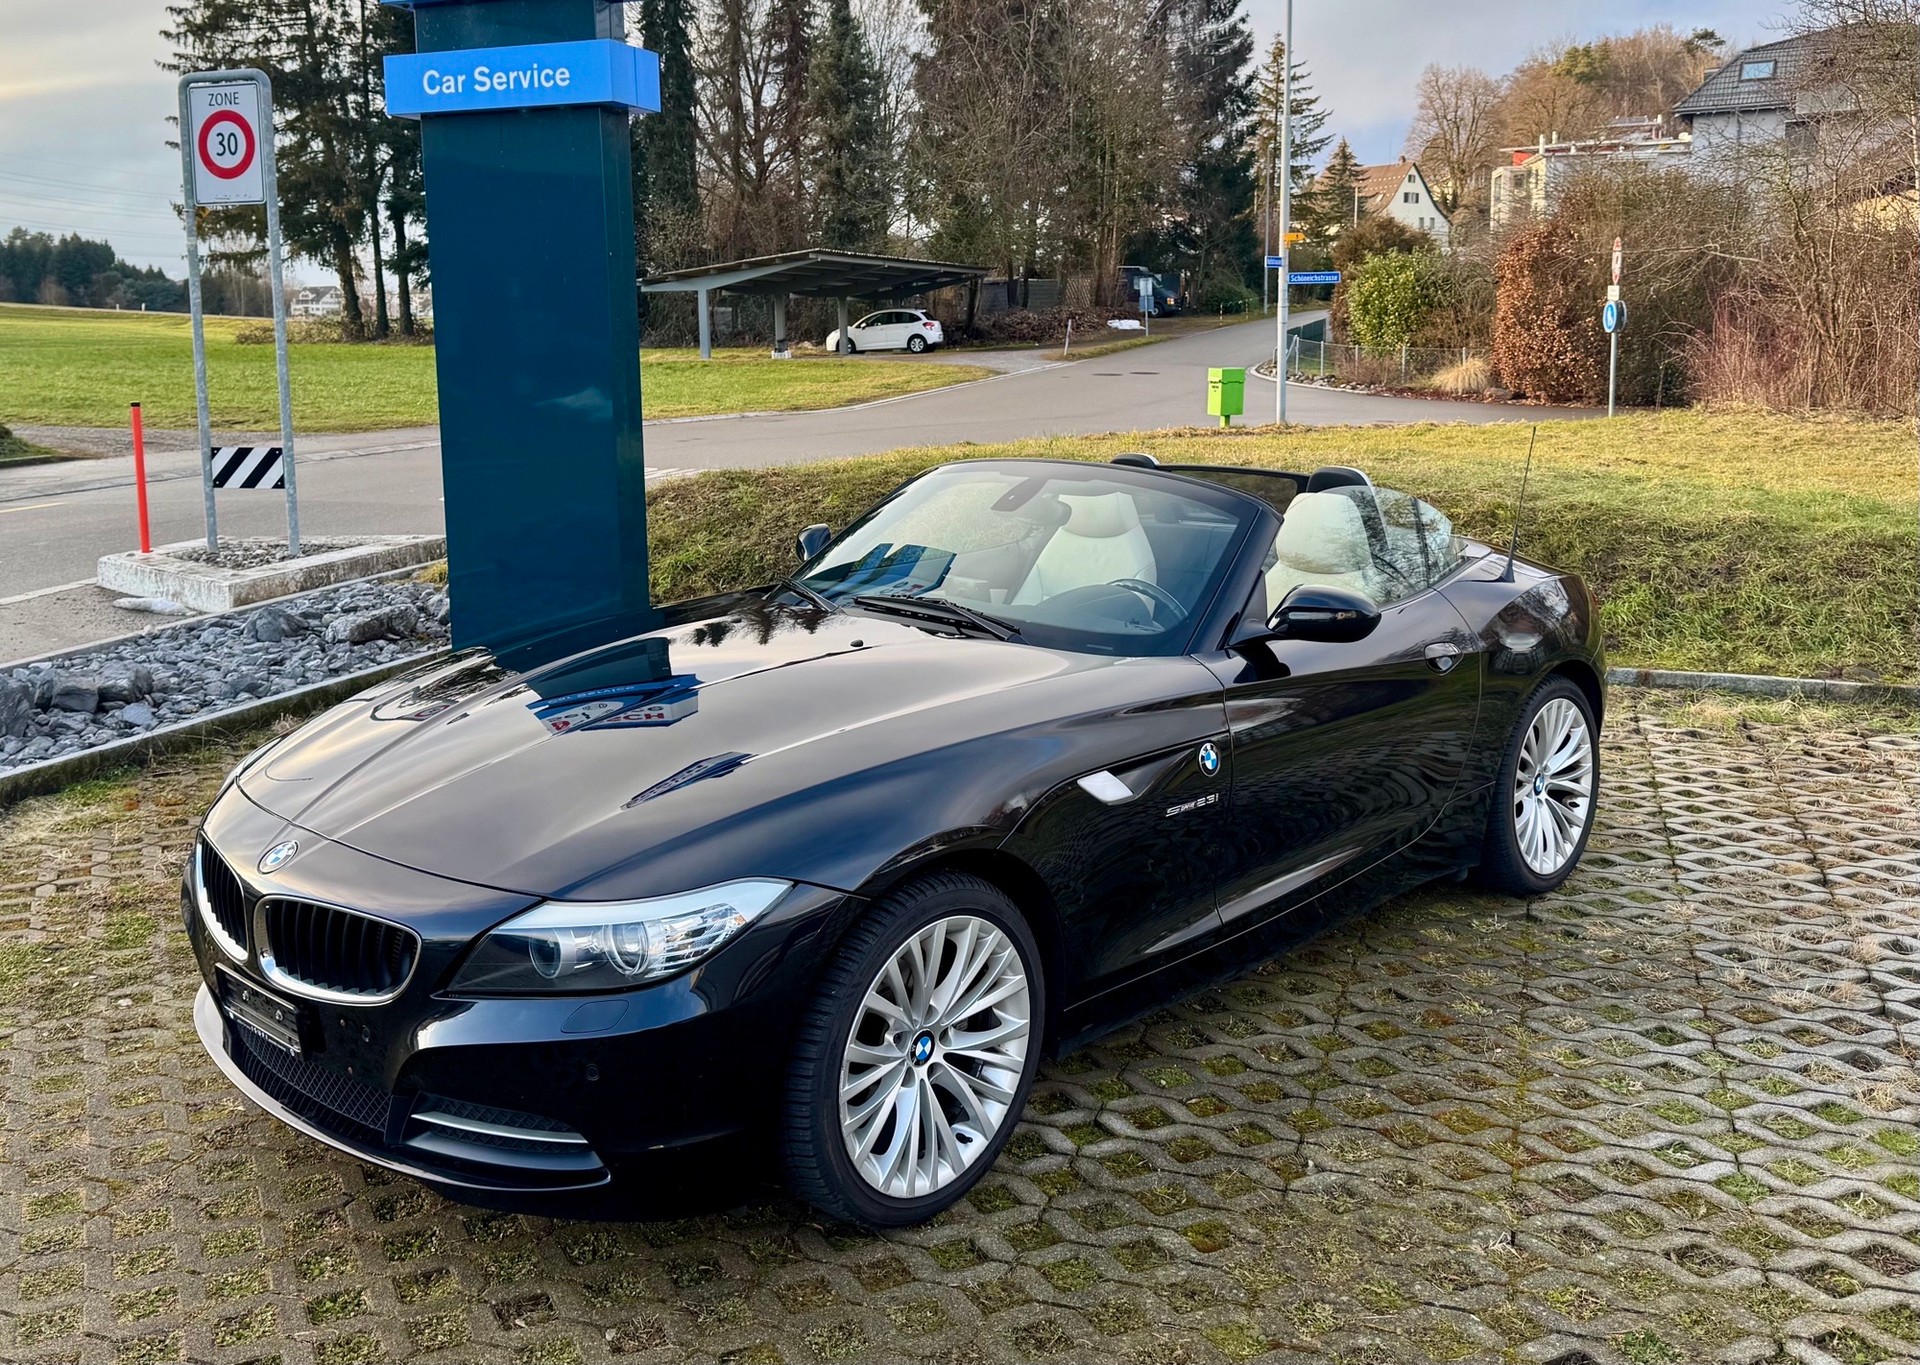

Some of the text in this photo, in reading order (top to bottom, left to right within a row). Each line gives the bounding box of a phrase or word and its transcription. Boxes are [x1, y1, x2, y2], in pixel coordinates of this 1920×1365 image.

[422, 63, 570, 95] Car Service
[208, 92, 240, 106] ZONE
[216, 132, 238, 156] 30
